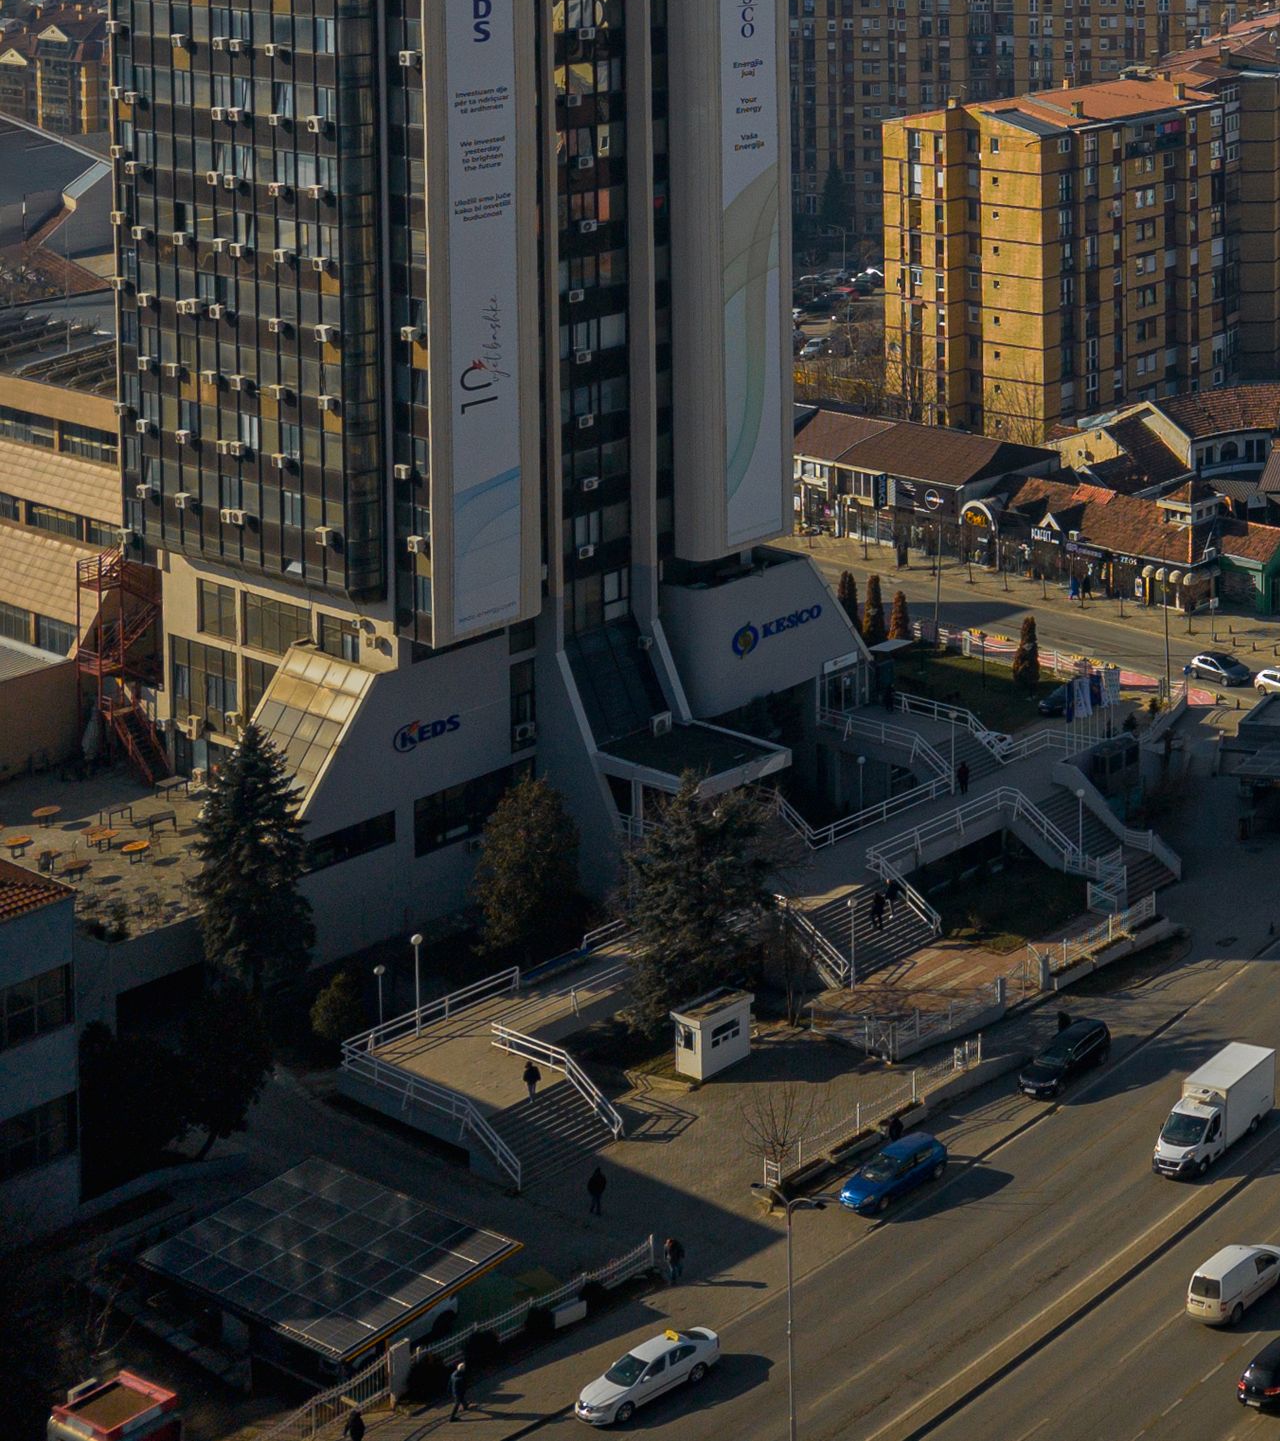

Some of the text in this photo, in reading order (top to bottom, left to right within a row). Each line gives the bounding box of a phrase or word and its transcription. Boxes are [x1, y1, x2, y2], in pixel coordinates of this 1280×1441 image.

[740, 96, 758, 104] Your
[736, 106, 763, 115] Energy
[394, 714, 461, 752] KEDS
